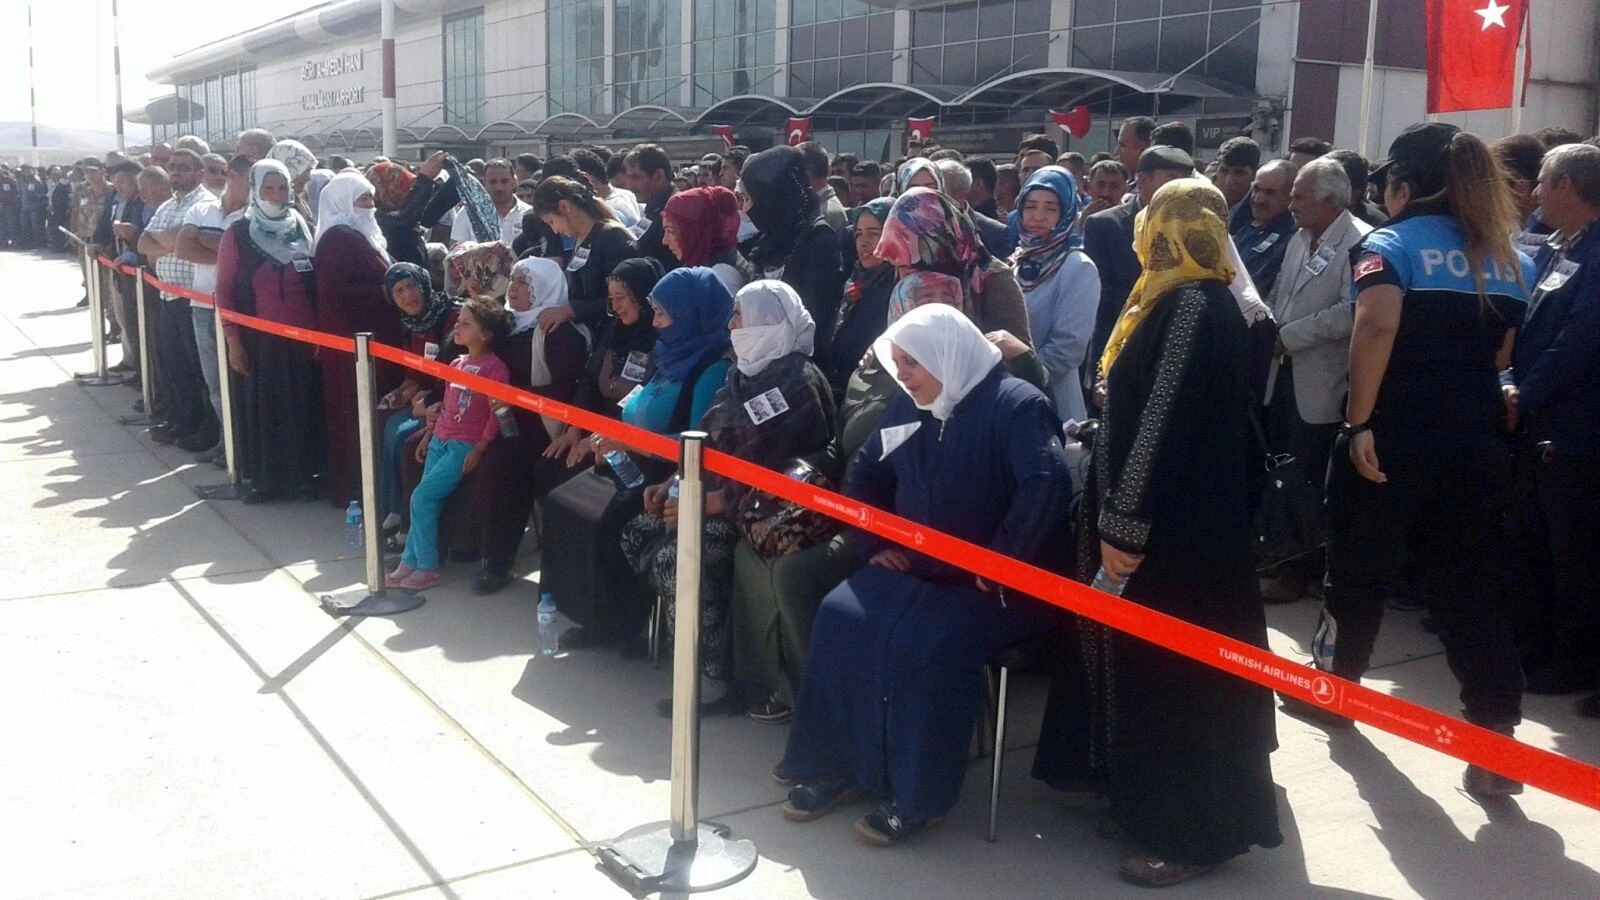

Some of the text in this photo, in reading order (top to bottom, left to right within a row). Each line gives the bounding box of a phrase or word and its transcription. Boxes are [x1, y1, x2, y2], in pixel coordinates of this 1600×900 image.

[1202, 127, 1220, 139] VIP
[1420, 248, 1517, 283] POIS
[1219, 647, 1311, 690] TURKISH AIRLINES
